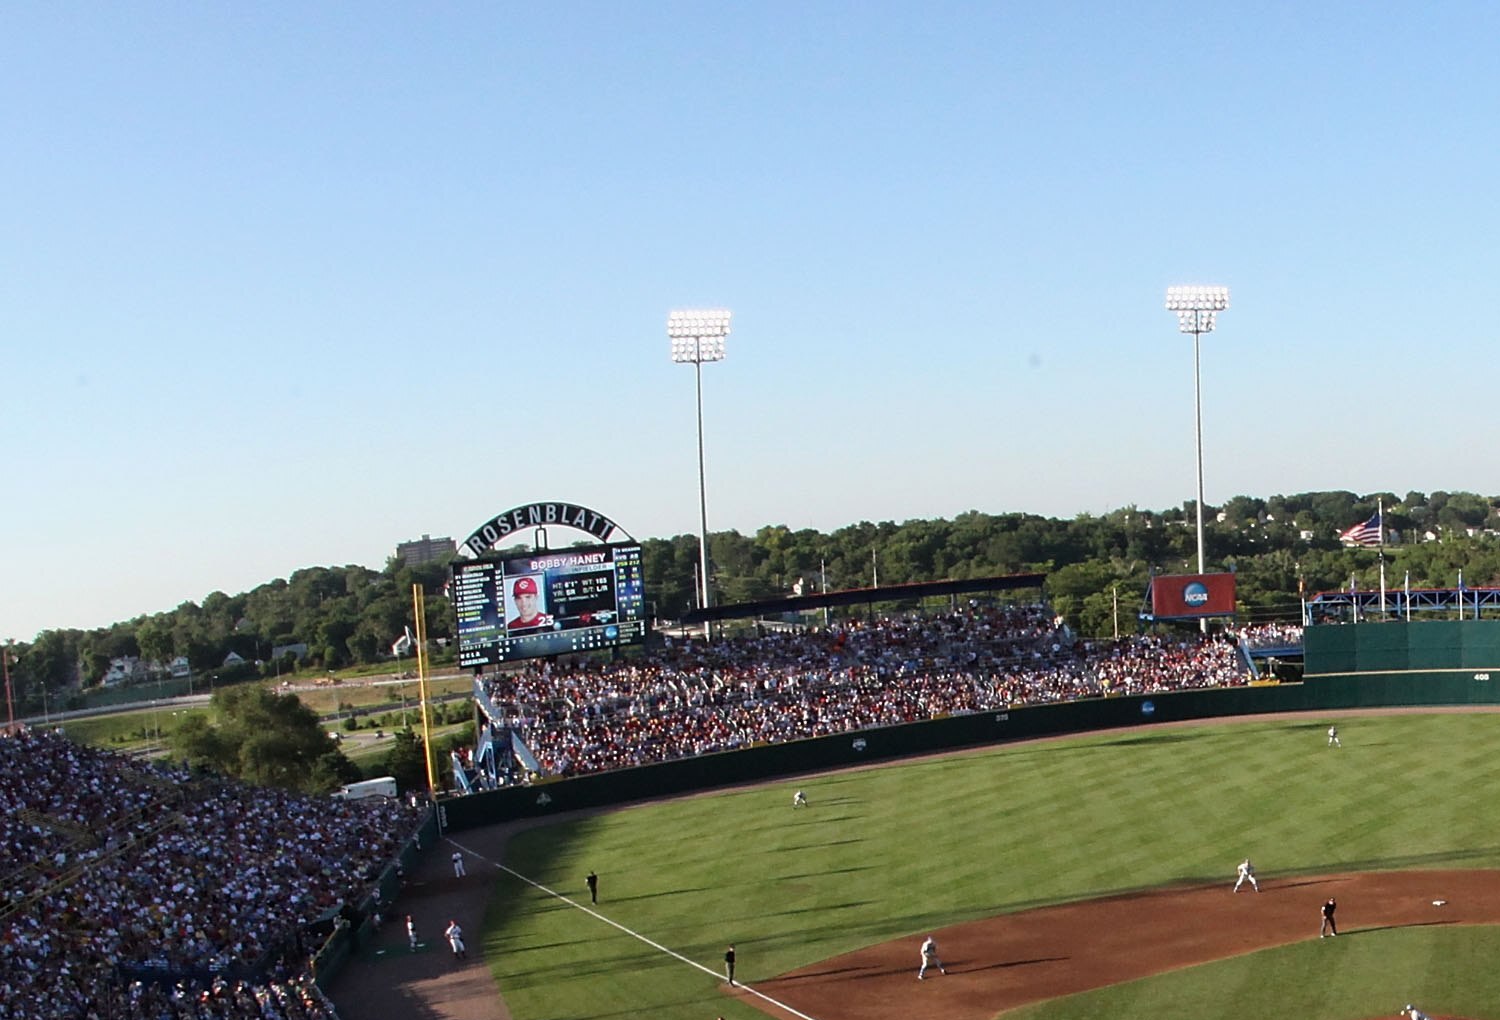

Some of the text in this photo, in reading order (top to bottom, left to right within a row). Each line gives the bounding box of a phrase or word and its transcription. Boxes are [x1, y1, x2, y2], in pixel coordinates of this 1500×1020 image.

[469, 504, 615, 554] ROSENBLATT
[530, 559, 568, 571] BOBBY
[568, 553, 606, 565] HANEY
[1184, 593, 1208, 602] NCAA
[538, 614, 554, 627] 23
[461, 657, 489, 666] CAROLINA
